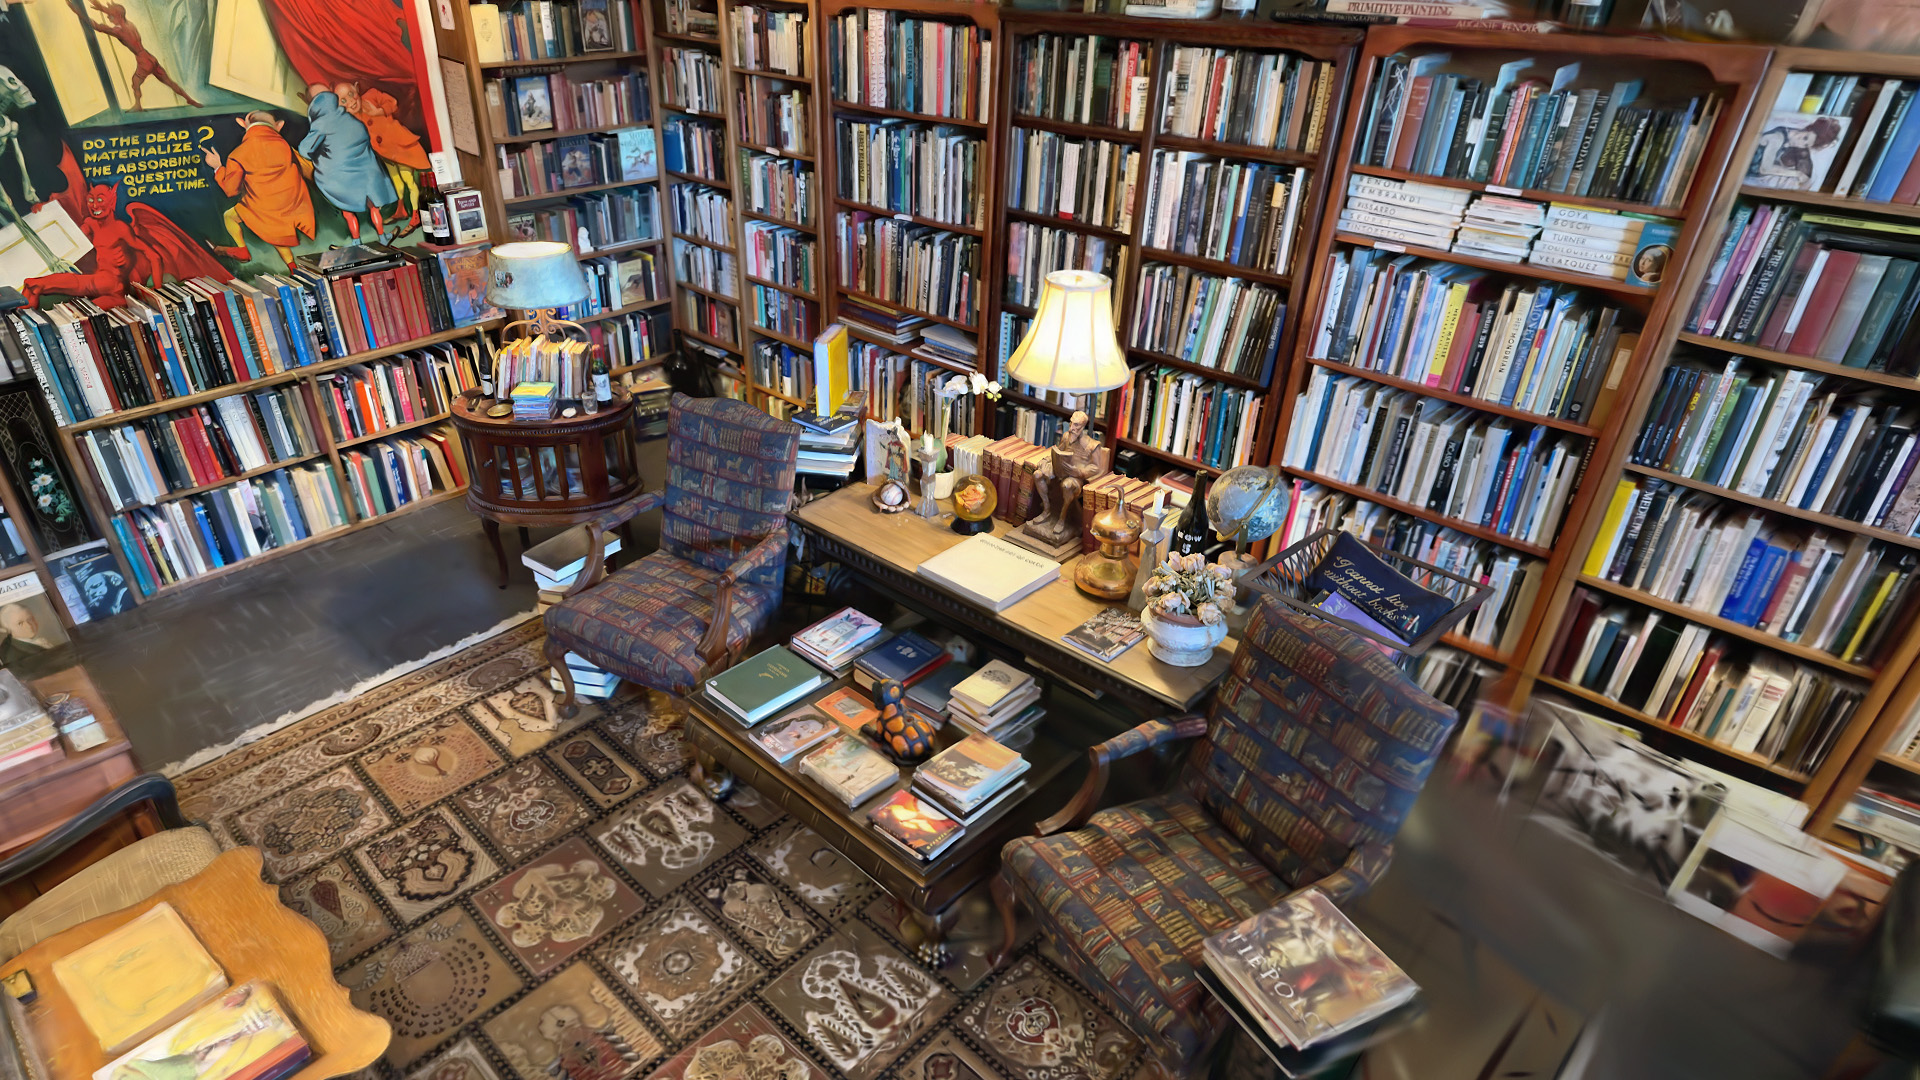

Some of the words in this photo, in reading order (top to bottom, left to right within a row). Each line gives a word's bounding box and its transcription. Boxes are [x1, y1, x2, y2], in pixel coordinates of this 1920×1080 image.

[1347, 1, 1402, 15] PRIMITIVE
[1403, 2, 1453, 16] PAINTING
[1125, 59, 1134, 88] POWER
[1586, 108, 1600, 133] ART
[83, 138, 105, 151] DO
[109, 135, 140, 147] THE
[145, 130, 189, 144] DEAD
[197, 125, 215, 149] ?
[84, 142, 193, 165] MATERIALIZE
[1573, 134, 1592, 171] TODAY
[1608, 133, 1631, 182] RENAISSANCE
[83, 164, 112, 178] THE
[116, 154, 202, 176] ABSORBING
[122, 167, 198, 186] QUESTION
[127, 186, 147, 198] OF
[149, 183, 174, 196] ALL
[175, 178, 209, 191] TIME.
[1553, 219, 1592, 232] BOSCH
[1559, 209, 1590, 221] GOYA
[1552, 233, 1588, 246] TURNER
[1538, 254, 1599, 272] VELAZQUEZ
[1542, 244, 1633, 264] TOULOUSE-LAUTRE
[1736, 246, 1785, 331] PRE-RAPHAELITES
[206, 317, 216, 332] THE
[1522, 302, 1543, 344] MONET
[210, 330, 220, 344] ART
[252, 324, 270, 361] BESTIARY
[1439, 329, 1453, 358] MATISSE
[217, 350, 229, 371] ROCK
[1497, 331, 1516, 373] MONDRIAN
[1442, 441, 1456, 468] PICASSO
[1626, 489, 1653, 541] MEDICINE
[1324, 570, 1368, 599] without
[1345, 567, 1386, 594] cannot
[1386, 592, 1409, 611] live
